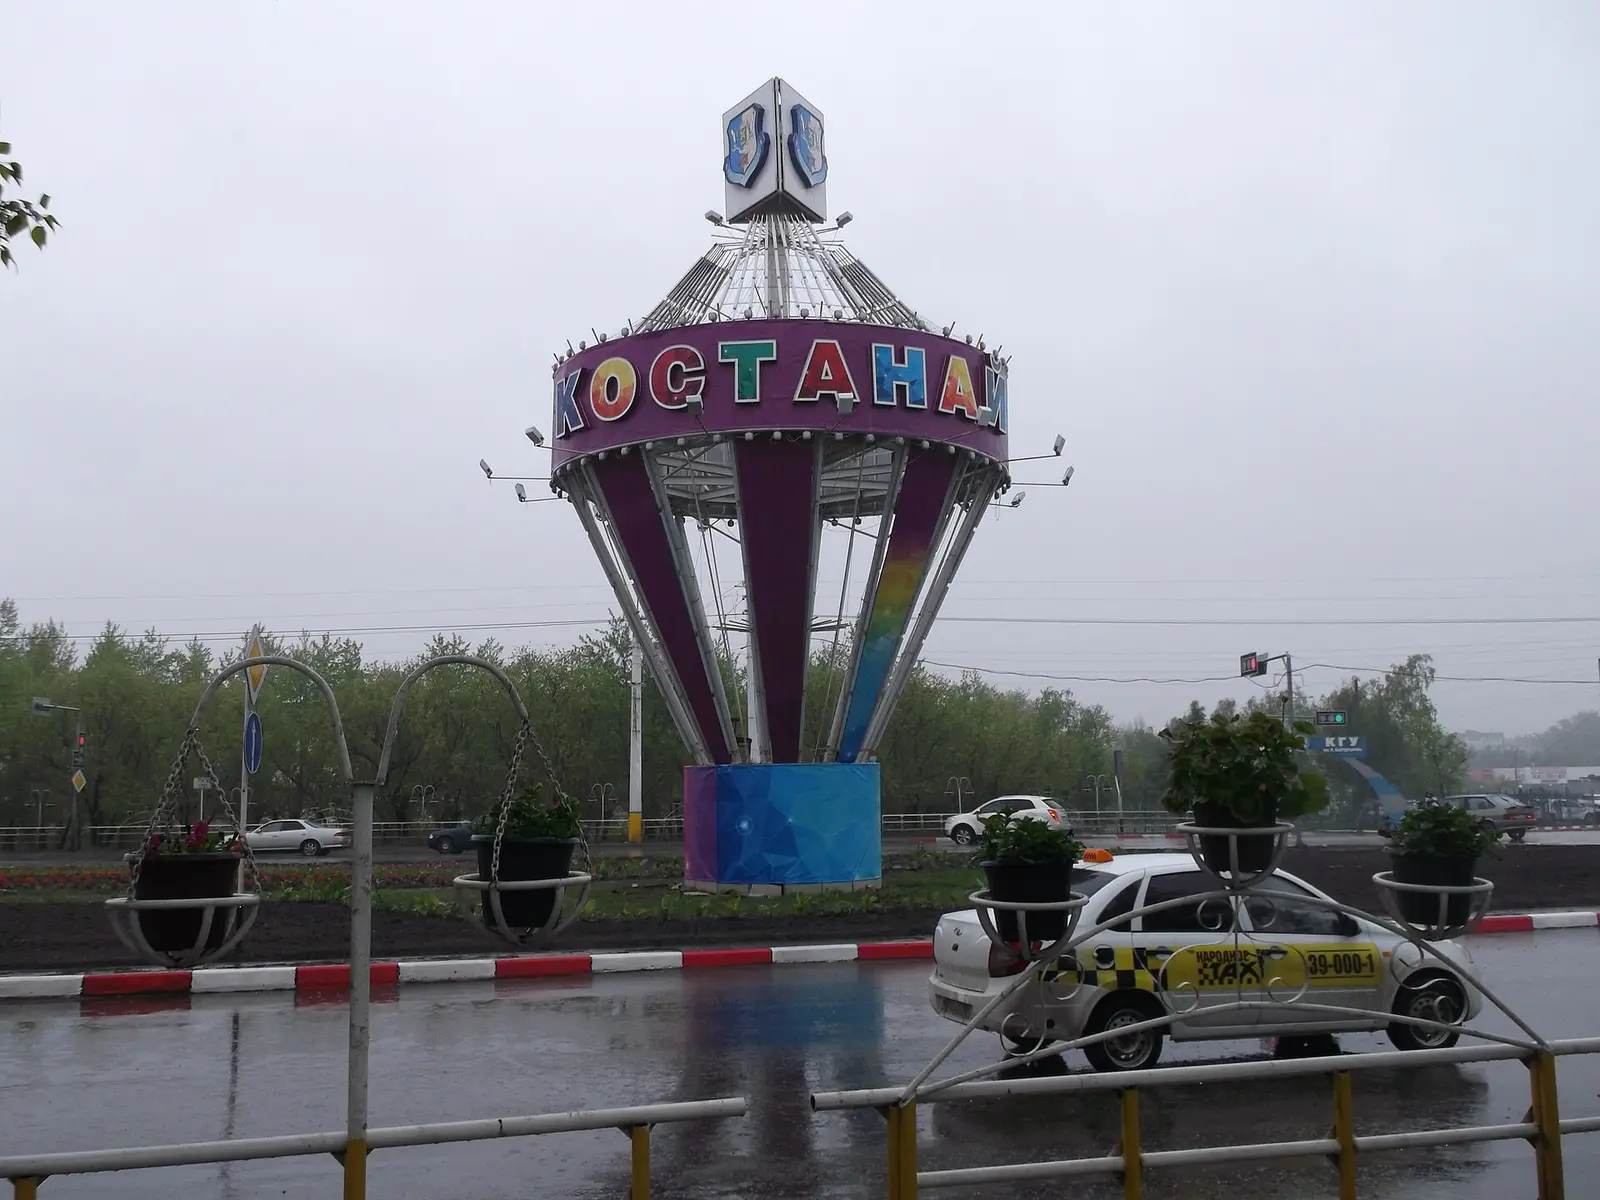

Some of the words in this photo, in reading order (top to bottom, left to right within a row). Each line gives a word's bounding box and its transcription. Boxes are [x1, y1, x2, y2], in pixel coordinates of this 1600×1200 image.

[556, 338, 1008, 439] КОСТАНАЙ
[1325, 736, 1359, 747] КГУ
[1308, 953, 1374, 975] 39-000-1
